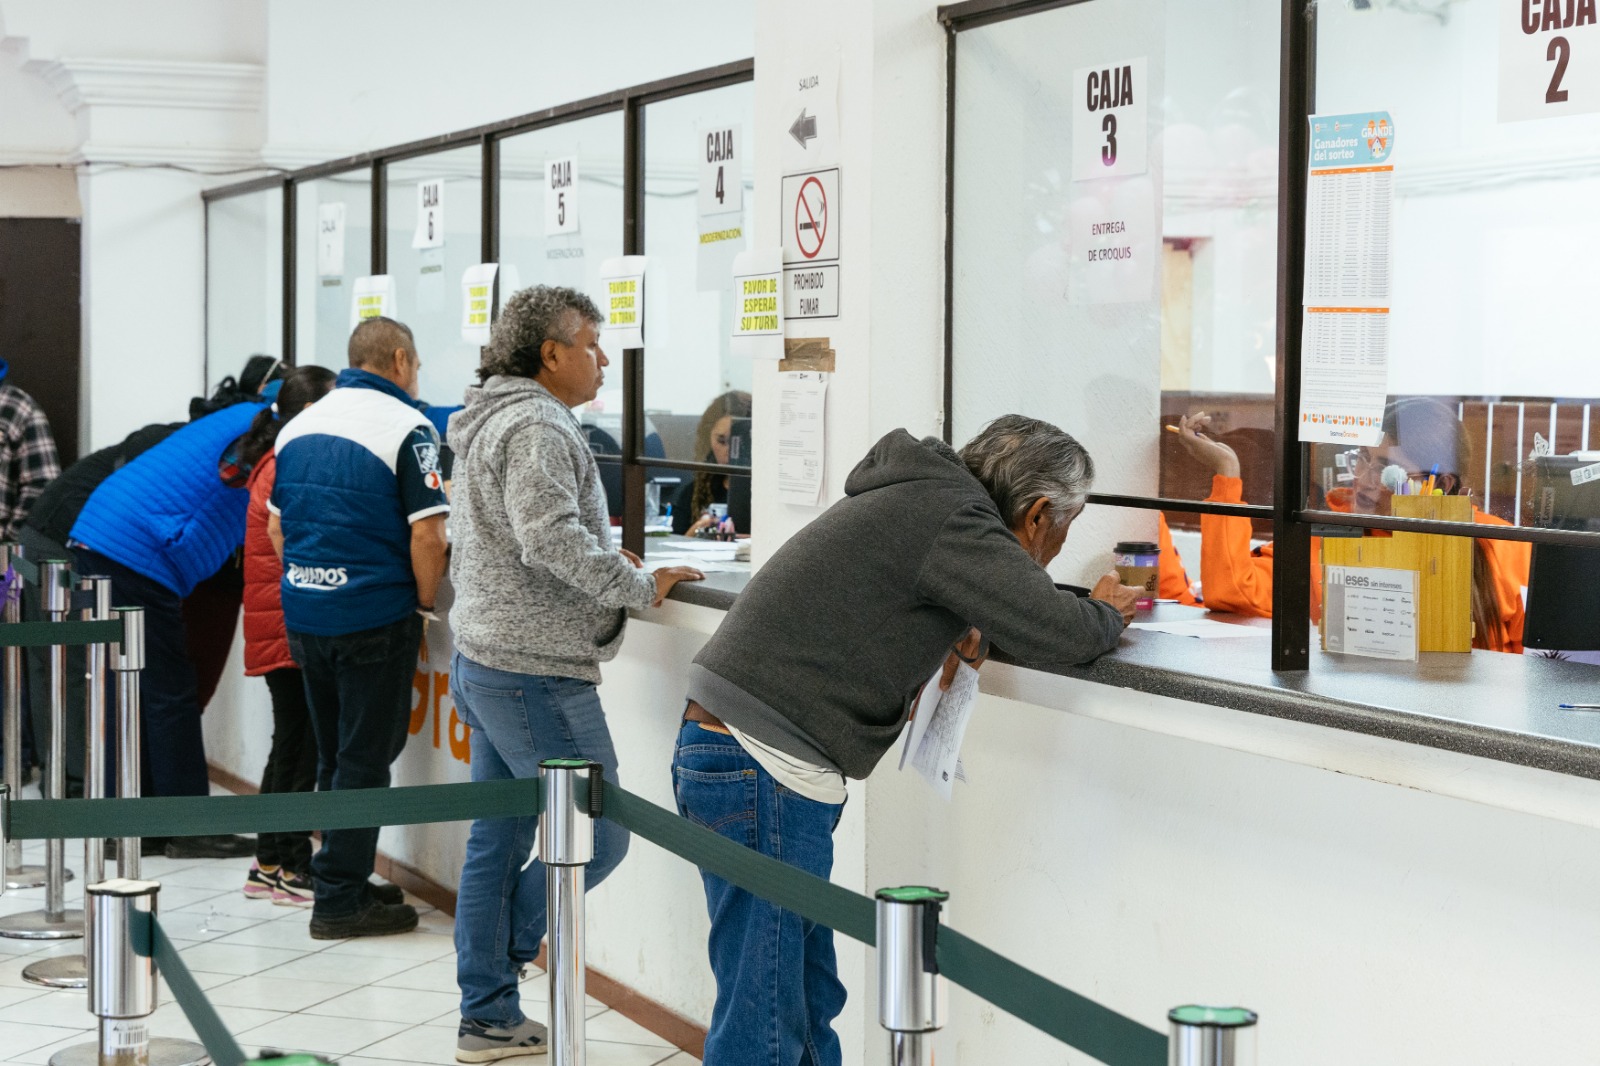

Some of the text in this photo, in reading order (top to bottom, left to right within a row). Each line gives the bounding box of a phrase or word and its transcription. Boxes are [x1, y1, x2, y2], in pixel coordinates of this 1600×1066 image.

[1521, 0, 1597, 35] CAJA
[1545, 36, 1570, 104] 2
[799, 74, 819, 92] SALIDA
[1086, 65, 1134, 112] CAJA
[706, 129, 734, 164] CAJA
[1102, 114, 1117, 167] 3
[1314, 137, 1359, 150] Ganadores
[1314, 149, 1355, 161] del sorteo
[551, 160, 572, 190] CAJA
[715, 166, 725, 205] 4
[558, 193, 565, 226] 5
[1092, 220, 1125, 235] ENTREGA
[1088, 246, 1132, 262] DE CROQUIS
[743, 279, 767, 295] FAVOR
[794, 271, 824, 290] PROHIBIDO
[800, 297, 819, 315] FUMAR
[741, 316, 752, 331] SU
